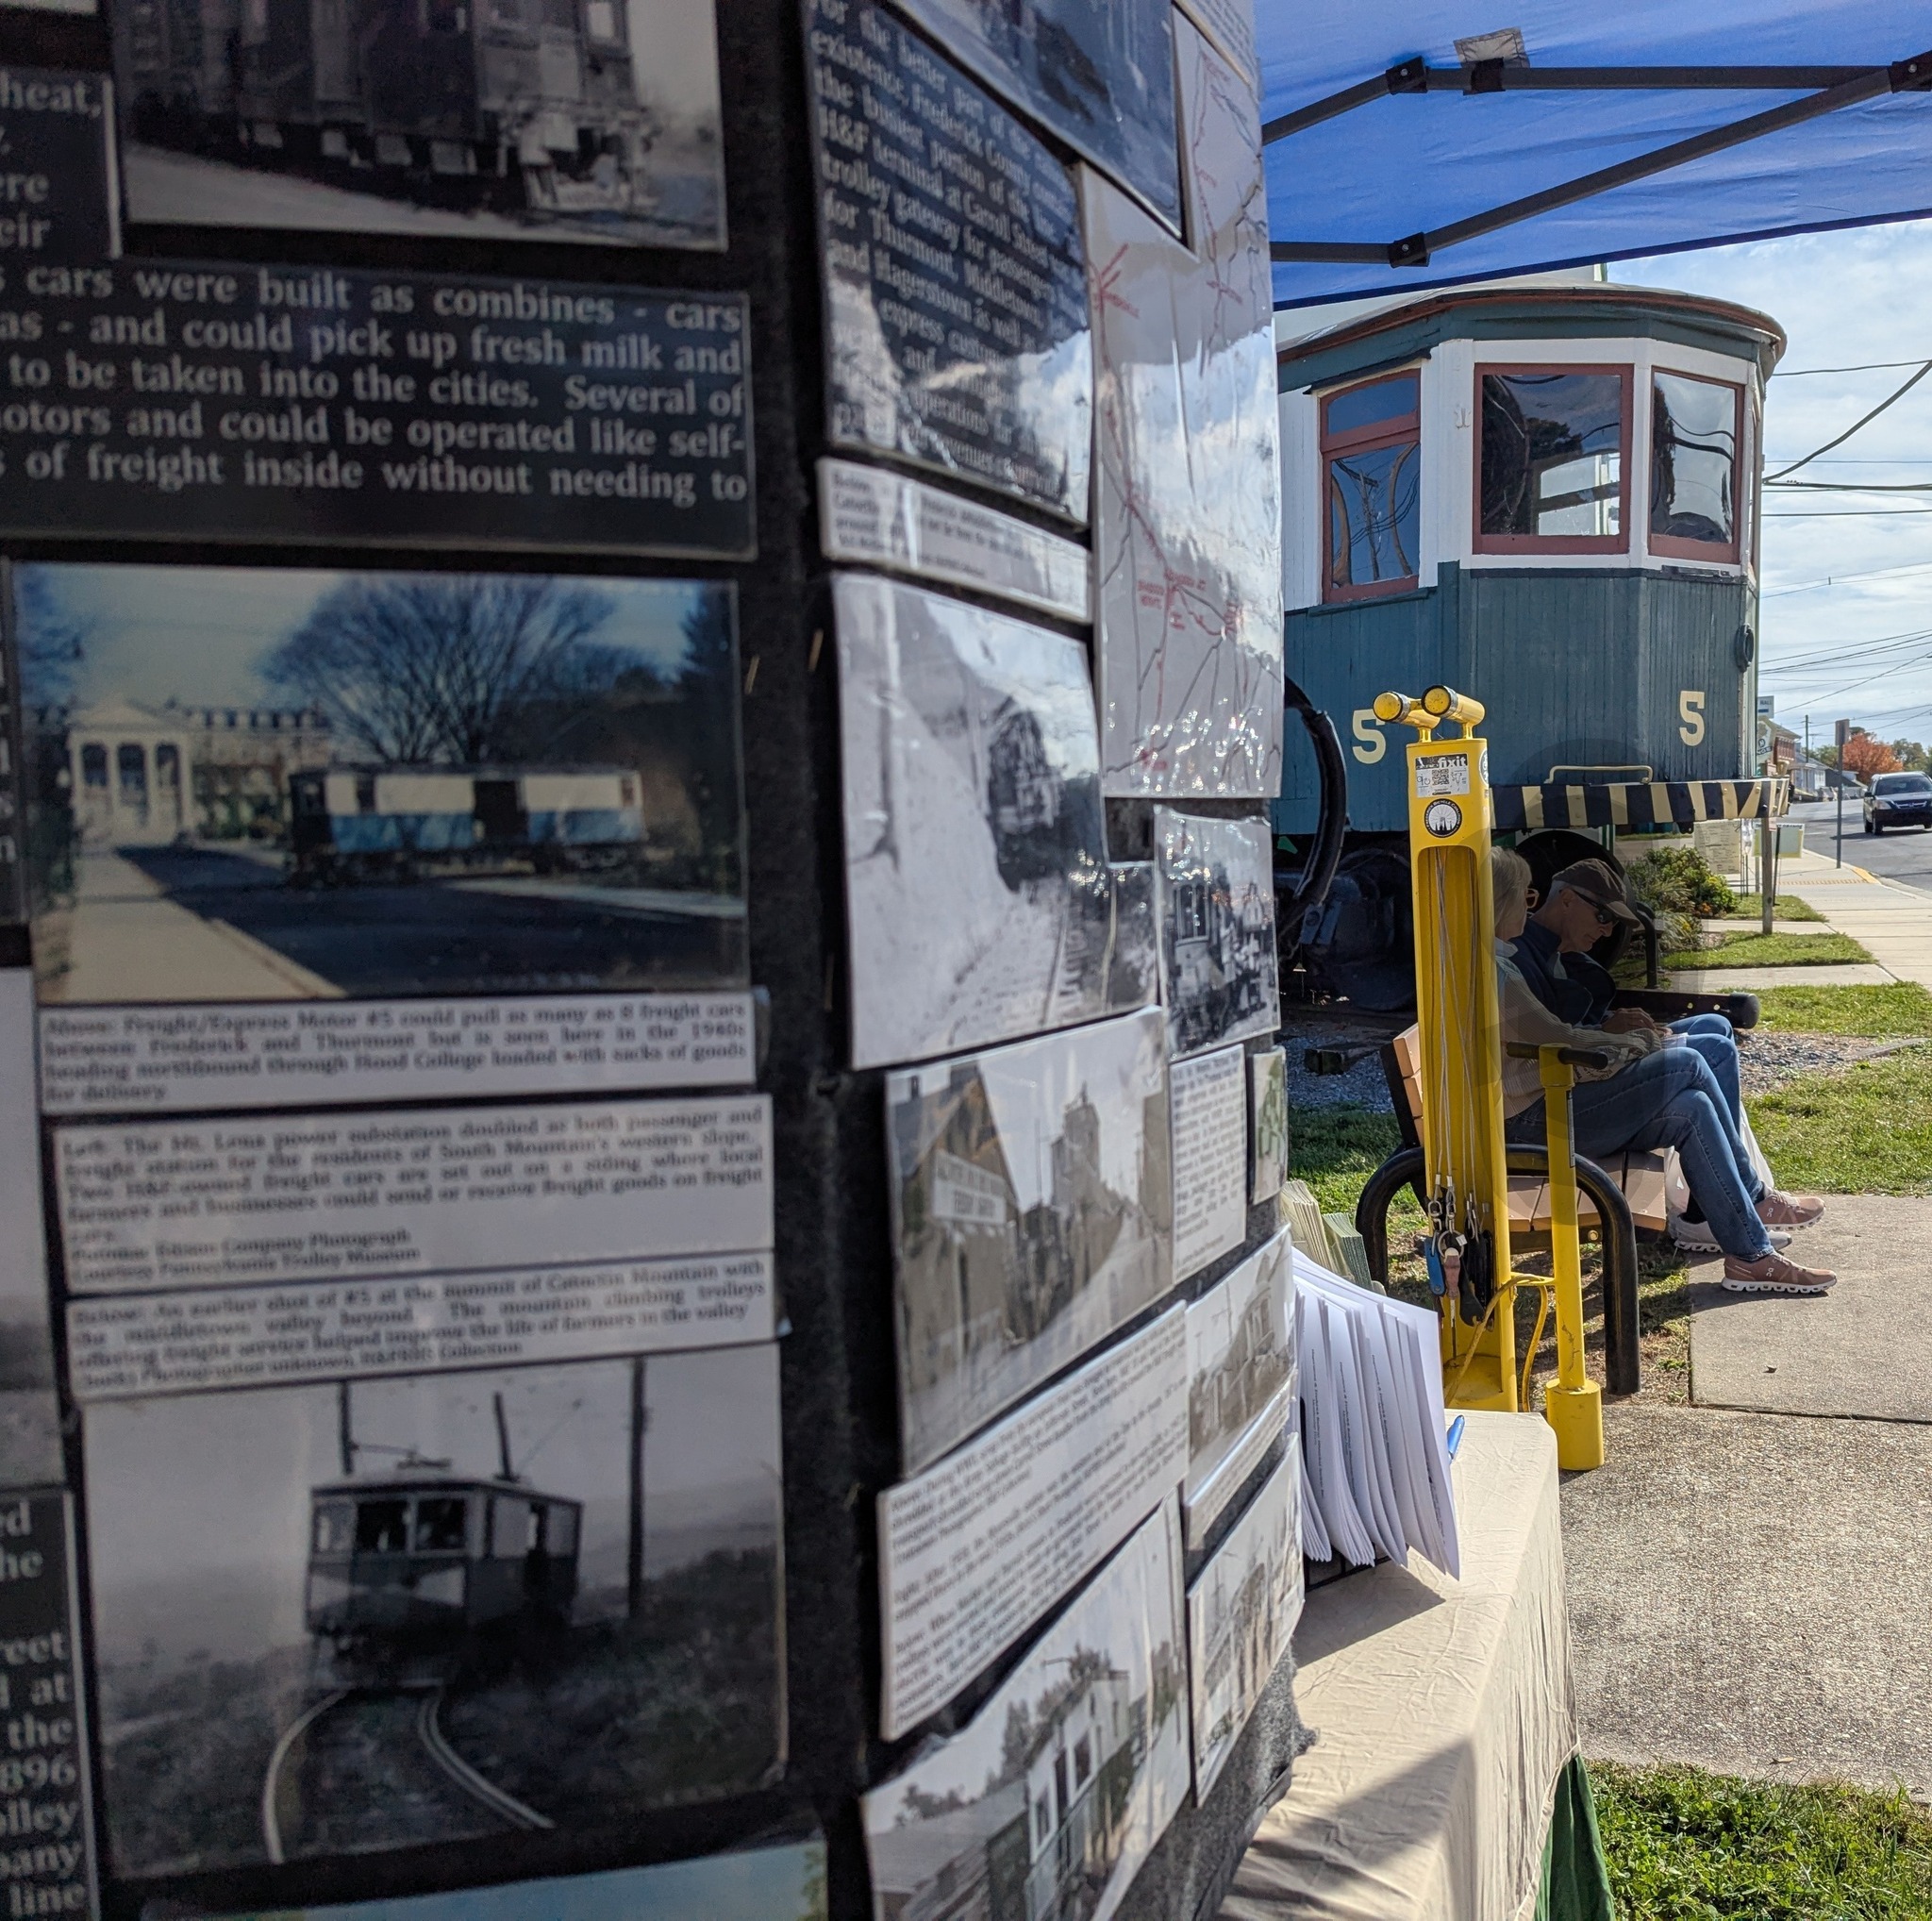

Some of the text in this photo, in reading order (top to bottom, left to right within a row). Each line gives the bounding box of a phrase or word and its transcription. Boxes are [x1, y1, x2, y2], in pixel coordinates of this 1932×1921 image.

[0, 71, 100, 119] heat,
[813, 66, 854, 108] the
[929, 140, 985, 192] portion
[989, 180, 1005, 205] of
[819, 104, 869, 154] H&F
[873, 134, 943, 201] terminal
[944, 186, 961, 214] at
[963, 192, 1010, 245] Carroll
[821, 151, 891, 213] trolley
[893, 189, 960, 253] gateway
[963, 225, 986, 260] for
[824, 187, 859, 230] for
[867, 208, 959, 283] Thurmont,
[963, 259, 1044, 330] Middletown,
[26, 267, 112, 297] cars
[136, 270, 238, 302] were
[259, 267, 350, 310] built
[371, 286, 414, 313] as
[434, 284, 615, 326] combines
[666, 303, 741, 331] cars
[825, 238, 871, 274] and
[874, 248, 973, 326] Hagerstown
[991, 317, 1019, 349] well
[91, 308, 166, 344] and
[182, 312, 293, 353] could
[309, 318, 395, 363] pick
[406, 330, 457, 369] up
[471, 325, 566, 365] fresh
[582, 334, 662, 370] milk
[675, 340, 741, 375] and
[877, 298, 945, 345] express
[8, 349, 745, 417] to be taken into the cities. Several of
[0, 399, 745, 459] otors and could be operated like self-
[25, 441, 747, 509] of freight inside without needing to
[1353, 709, 1386, 764] 5
[1680, 691, 1705, 746] 5
[1438, 756, 1466, 768] fixit
[398, 1008, 454, 1026] could
[461, 1005, 500, 1027] pull
[533, 1008, 587, 1025] many
[640, 1002, 700, 1021] freight
[706, 1004, 745, 1018] cars
[560, 1024, 604, 1043] here
[647, 1024, 678, 1039] the
[415, 1051, 486, 1072] College
[492, 1046, 557, 1064] loaded
[668, 1043, 686, 1061] of
[691, 1043, 746, 1063] goods
[703, 1169, 762, 1187] freight
[697, 1281, 765, 1300] trolleys
[31, 1675, 67, 1706] at
[9, 1712, 72, 1751] the
[9, 1885, 85, 1919] line
